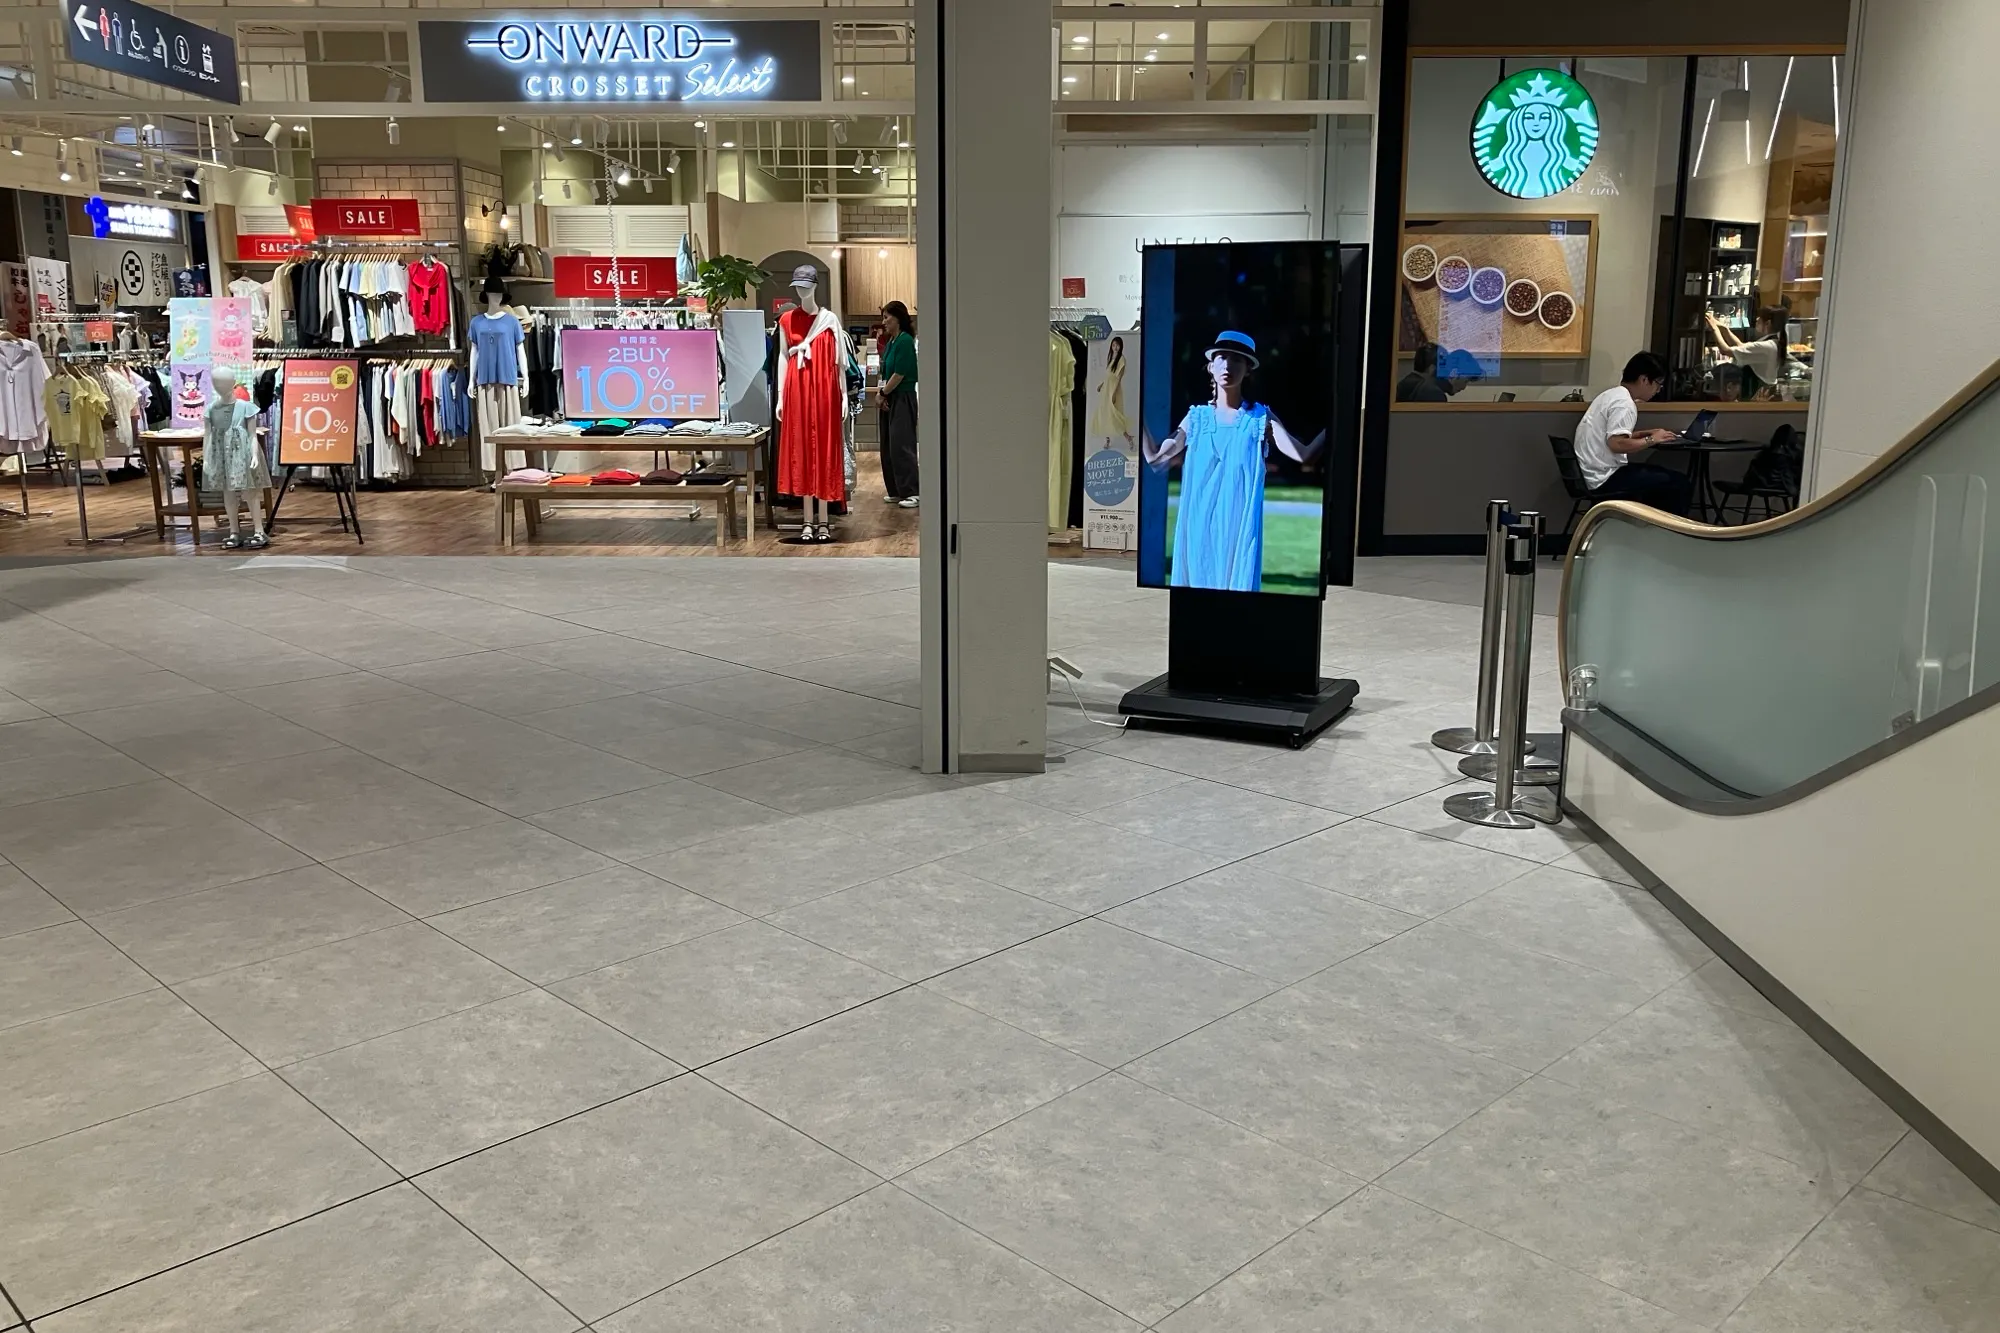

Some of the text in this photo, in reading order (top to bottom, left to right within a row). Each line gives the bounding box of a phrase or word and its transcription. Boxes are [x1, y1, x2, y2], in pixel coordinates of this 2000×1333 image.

[499, 22, 701, 63] ONWARD
[526, 57, 775, 101] CROSSET Select
[299, 217, 314, 230] SAL
[346, 211, 386, 224] SALE
[593, 270, 639, 285] SALE
[608, 347, 671, 363] 2BUY
[576, 365, 675, 413] 10%
[302, 393, 339, 402] 2BUY
[649, 394, 706, 413] OFF
[292, 406, 349, 435] 10%
[300, 438, 337, 451] OFF
[1087, 457, 1124, 470] BREEZE
[1087, 468, 1115, 480] MOVE
